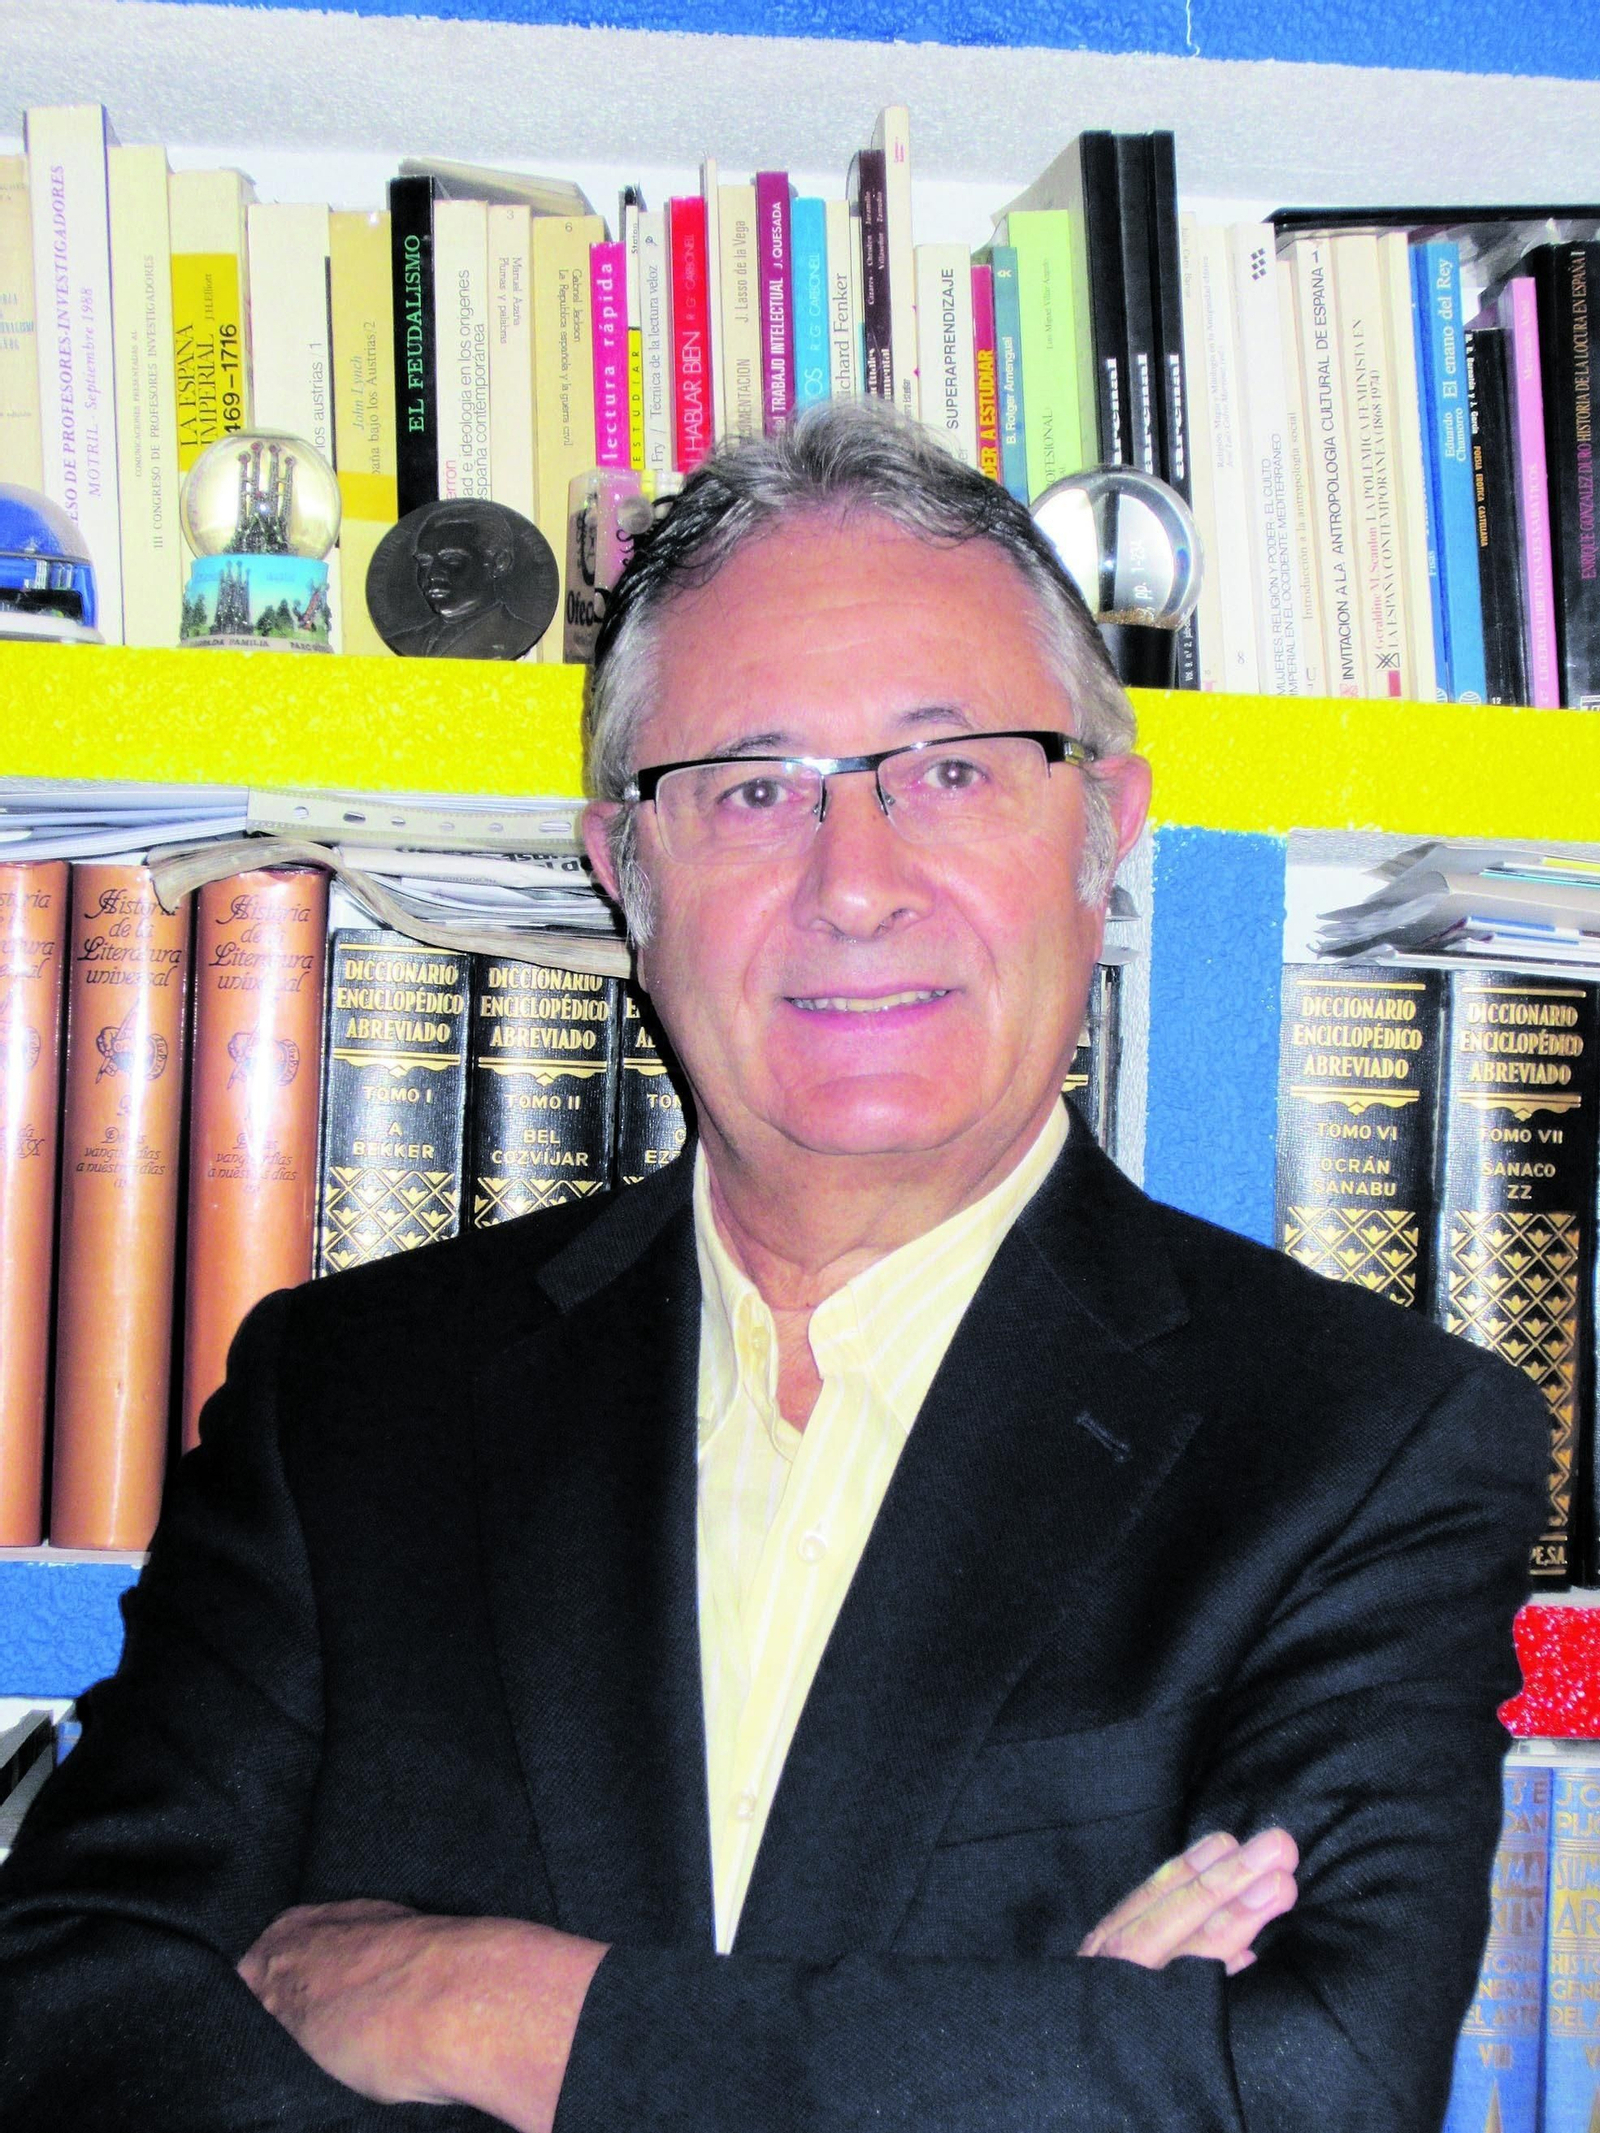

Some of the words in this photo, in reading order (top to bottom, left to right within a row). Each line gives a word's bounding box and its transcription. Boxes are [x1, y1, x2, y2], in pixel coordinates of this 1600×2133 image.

[733, 220, 748, 247] Vega
[771, 201, 783, 260] QUESADA
[733, 249, 747, 259] la
[773, 260, 783, 270] J.
[499, 256, 509, 290] Plumas
[512, 256, 522, 293] Manuel
[648, 265, 659, 295] veloz
[735, 263, 747, 276] de
[1436, 258, 1454, 291] Rey
[572, 267, 583, 303] Gabriel
[736, 279, 749, 310] Lasso
[80, 286, 94, 323] 1988
[144, 254, 157, 358] INVESTIGADORES
[405, 234, 423, 390] FEUDALISMO
[512, 296, 522, 326] Azaña
[598, 262, 615, 348] rápida
[769, 276, 785, 355] INTELECTUAL
[834, 271, 849, 333] Fenker
[1436, 294, 1454, 321] del
[1572, 299, 1586, 314] EN
[499, 304, 508, 346] palabras
[572, 307, 583, 343] Jackson
[649, 297, 660, 338] lectura
[1351, 319, 1364, 339] EN
[309, 341, 321, 349] 1
[458, 339, 472, 362] los
[559, 330, 570, 372] española
[648, 340, 660, 352] la
[943, 268, 957, 431] SUPERAPRENDIZAJE
[1315, 329, 1328, 351] DE
[1442, 324, 1457, 375] enano
[1573, 315, 1589, 360] LOCURA
[649, 354, 661, 369] de
[681, 332, 701, 374] BIEN
[1001, 336, 1015, 393] Amengual
[83, 327, 97, 411] Septiembre
[350, 355, 364, 394] Lynch
[461, 365, 472, 386] en
[474, 323, 487, 443] contemporánea
[1573, 361, 1590, 377] LA
[198, 332, 217, 445] IMPERIAL
[312, 361, 325, 421] austrias
[561, 382, 572, 391] la
[650, 371, 662, 419] Técnica
[770, 359, 786, 413] TRABAJO
[977, 348, 996, 425] ESTUDIAR
[1319, 356, 1333, 432] CULTURAL
[1442, 380, 1458, 399] El
[1574, 377, 1590, 393] DE
[148, 362, 159, 439] PROFESORES
[352, 398, 365, 431] John
[368, 391, 378, 410] los
[408, 398, 425, 433] EL
[560, 393, 570, 423] guerra
[602, 365, 618, 462] lectura
[683, 379, 703, 452] HABLAR
[180, 417, 198, 448] LA
[369, 413, 380, 443] bajo
[1287, 411, 1298, 444] social
[1575, 394, 1592, 443] HISTORIA
[313, 426, 326, 450] los
[563, 426, 573, 447] civil
[979, 429, 997, 442] A
[1005, 432, 1017, 446] B.
[1443, 412, 1457, 458] Eduardo
[1452, 407, 1466, 462] Chamorro
[150, 444, 160, 461] DE
[463, 461, 474, 473] e
[652, 442, 665, 464] Fry
[1578, 442, 1593, 474] DURO
[64, 459, 77, 485] DE
[1261, 458, 1273, 498] CULTO
[152, 465, 162, 531] CONGRESO
[1265, 500, 1274, 515] EL
[1326, 435, 1343, 556] ANTROPOLOGIA
[1365, 506, 1378, 522] LA
[1478, 505, 1488, 547] CASTELLANA
[154, 535, 164, 550] III
[1368, 526, 1380, 574] Scanlon
[1581, 532, 1599, 579] ENRIQUE
[1278, 532, 1290, 601] OCCIDENTE
[1333, 562, 1347, 583] LA
[1300, 546, 1313, 620] Introducción
[1335, 584, 1348, 597] A
[1282, 603, 1293, 619] EL
[1371, 592, 1387, 651] Geraldine
[1284, 621, 1294, 638] EN
[1338, 600, 1353, 682] INVITACION
[1387, 630, 1399, 649] LA
[1285, 640, 1298, 696] IMPERIAL
[1491, 696, 1502, 707] 12
[109, 917, 131, 938] de
[346, 959, 458, 986] DICCIONARIO
[488, 966, 603, 992] DICCIONARIO
[336, 986, 464, 1015] ENCICLOPÉDICO
[480, 991, 609, 1022] ENCICLOPÉDICO
[1301, 994, 1417, 1021] DICCIONARIO
[1467, 1001, 1579, 1027] DICCIONARIO
[345, 1018, 451, 1043] ABREVIADO
[490, 1025, 597, 1051] ABREVIADO
[1293, 1021, 1423, 1051] ENCICLOPÉDICO
[1459, 1028, 1585, 1058] ENCICLOPÉDICO
[1304, 1053, 1410, 1080] ABREVIADO
[1470, 1059, 1573, 1086] ABREVIADO
[363, 1086, 421, 1103] TOMO
[505, 1093, 561, 1110] TOMO
[567, 1095, 581, 1111] II
[387, 1121, 403, 1137] A
[523, 1129, 560, 1145] BEL
[1316, 1123, 1371, 1141] TOMO
[1376, 1125, 1399, 1142] VI
[1536, 1127, 1564, 1145] VII
[352, 1141, 435, 1160] BEKKER
[491, 1146, 589, 1167] COZVÍJAR
[1320, 1154, 1391, 1175] OCRÁN
[1482, 1161, 1556, 1179] SANACO
[1312, 1177, 1397, 1198] SANABU
[1506, 1184, 1533, 1200] ZZ
